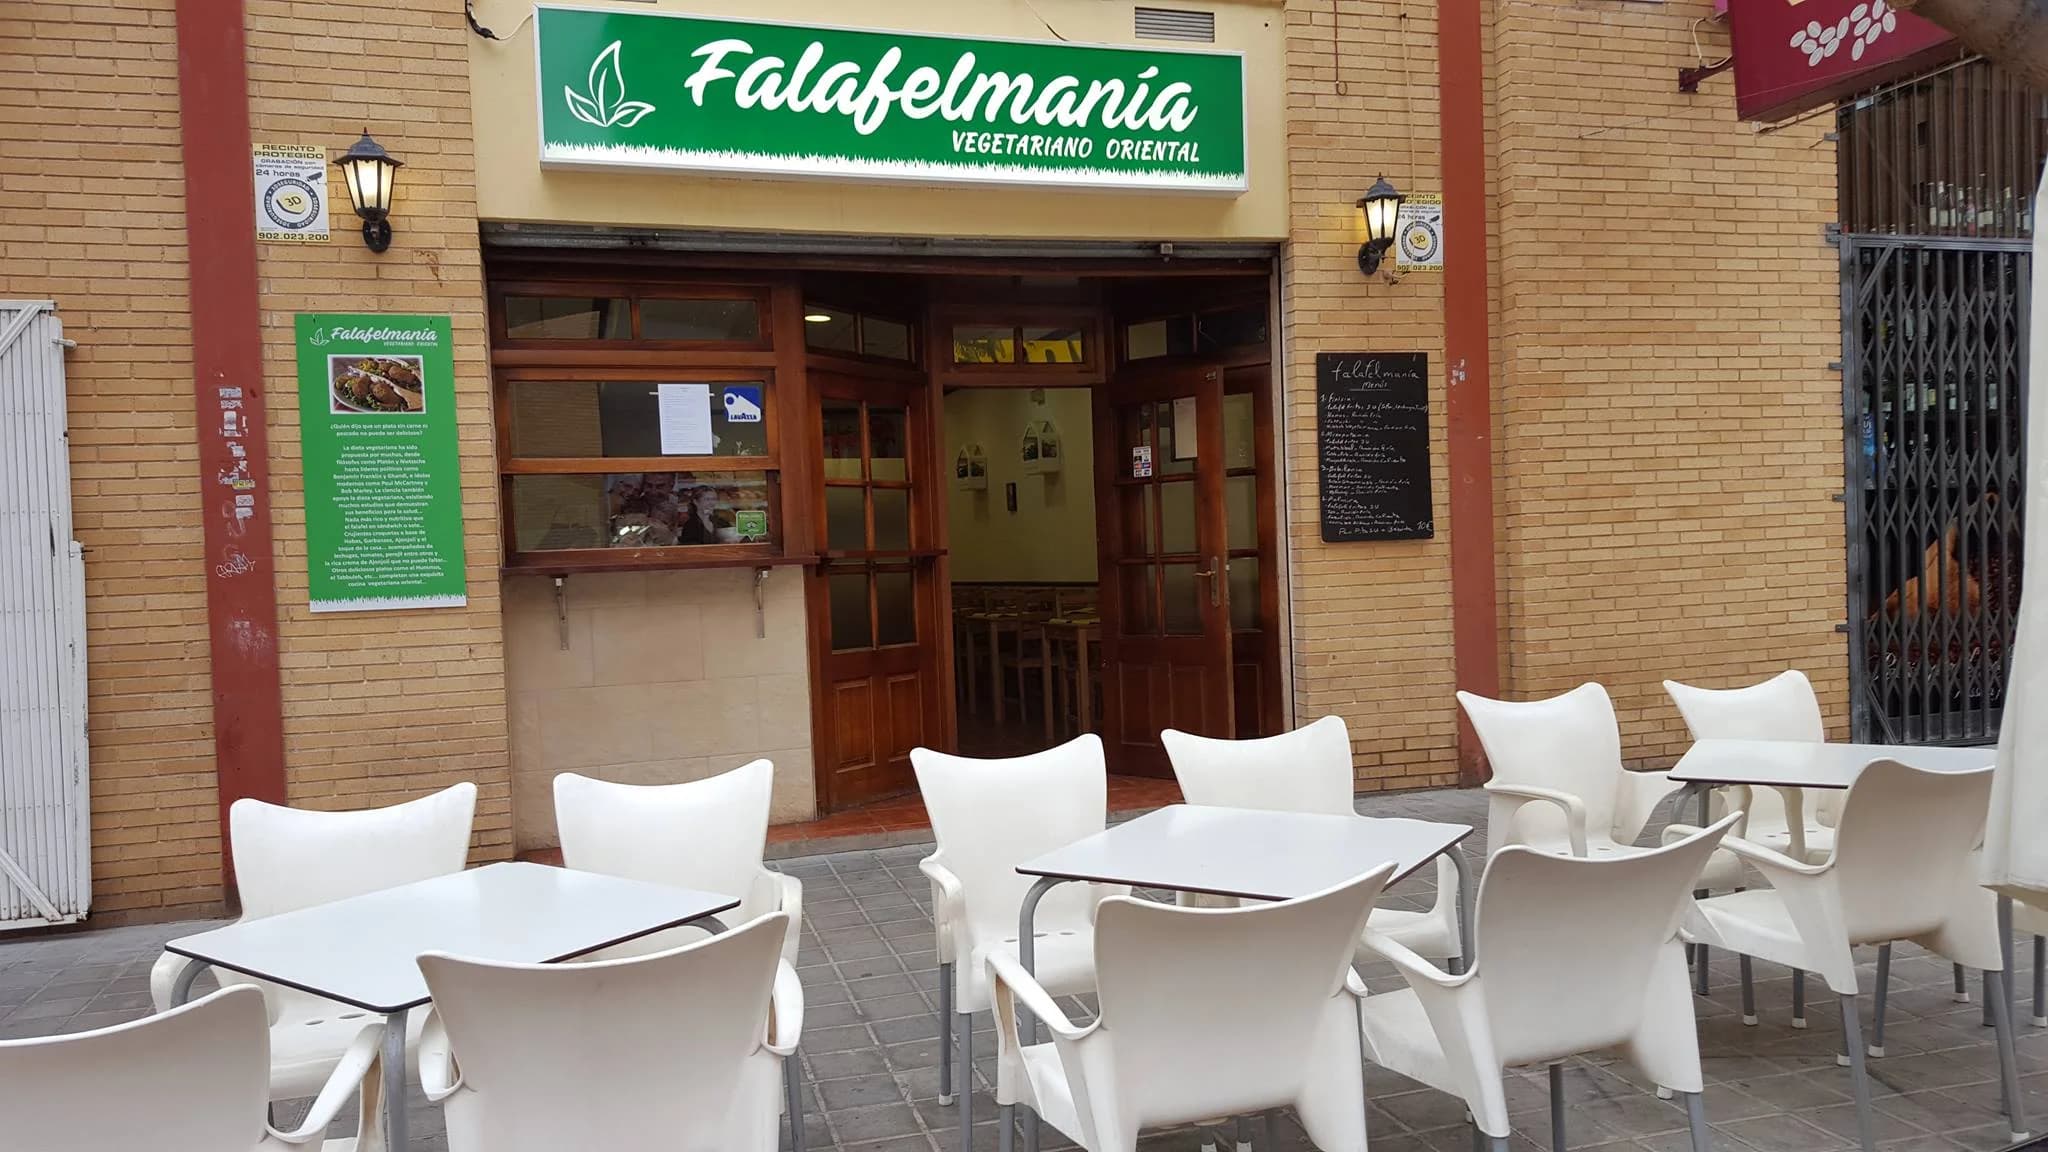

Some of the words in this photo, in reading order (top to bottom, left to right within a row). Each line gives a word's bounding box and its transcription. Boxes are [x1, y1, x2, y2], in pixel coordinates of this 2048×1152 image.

[684, 38, 1199, 136] Falafelmanía
[262, 144, 315, 152] RECINTO
[952, 130, 1094, 159] VEGETARIANO
[1105, 139, 1200, 163] ORIENTAL
[254, 151, 324, 160] PROTEGIDO
[255, 168, 270, 176] 24
[273, 169, 301, 177] horas
[285, 196, 302, 207] 3D
[258, 232, 329, 241] 902.023.200
[1414, 234, 1426, 244] 3D
[330, 326, 438, 343] Falafelmanía
